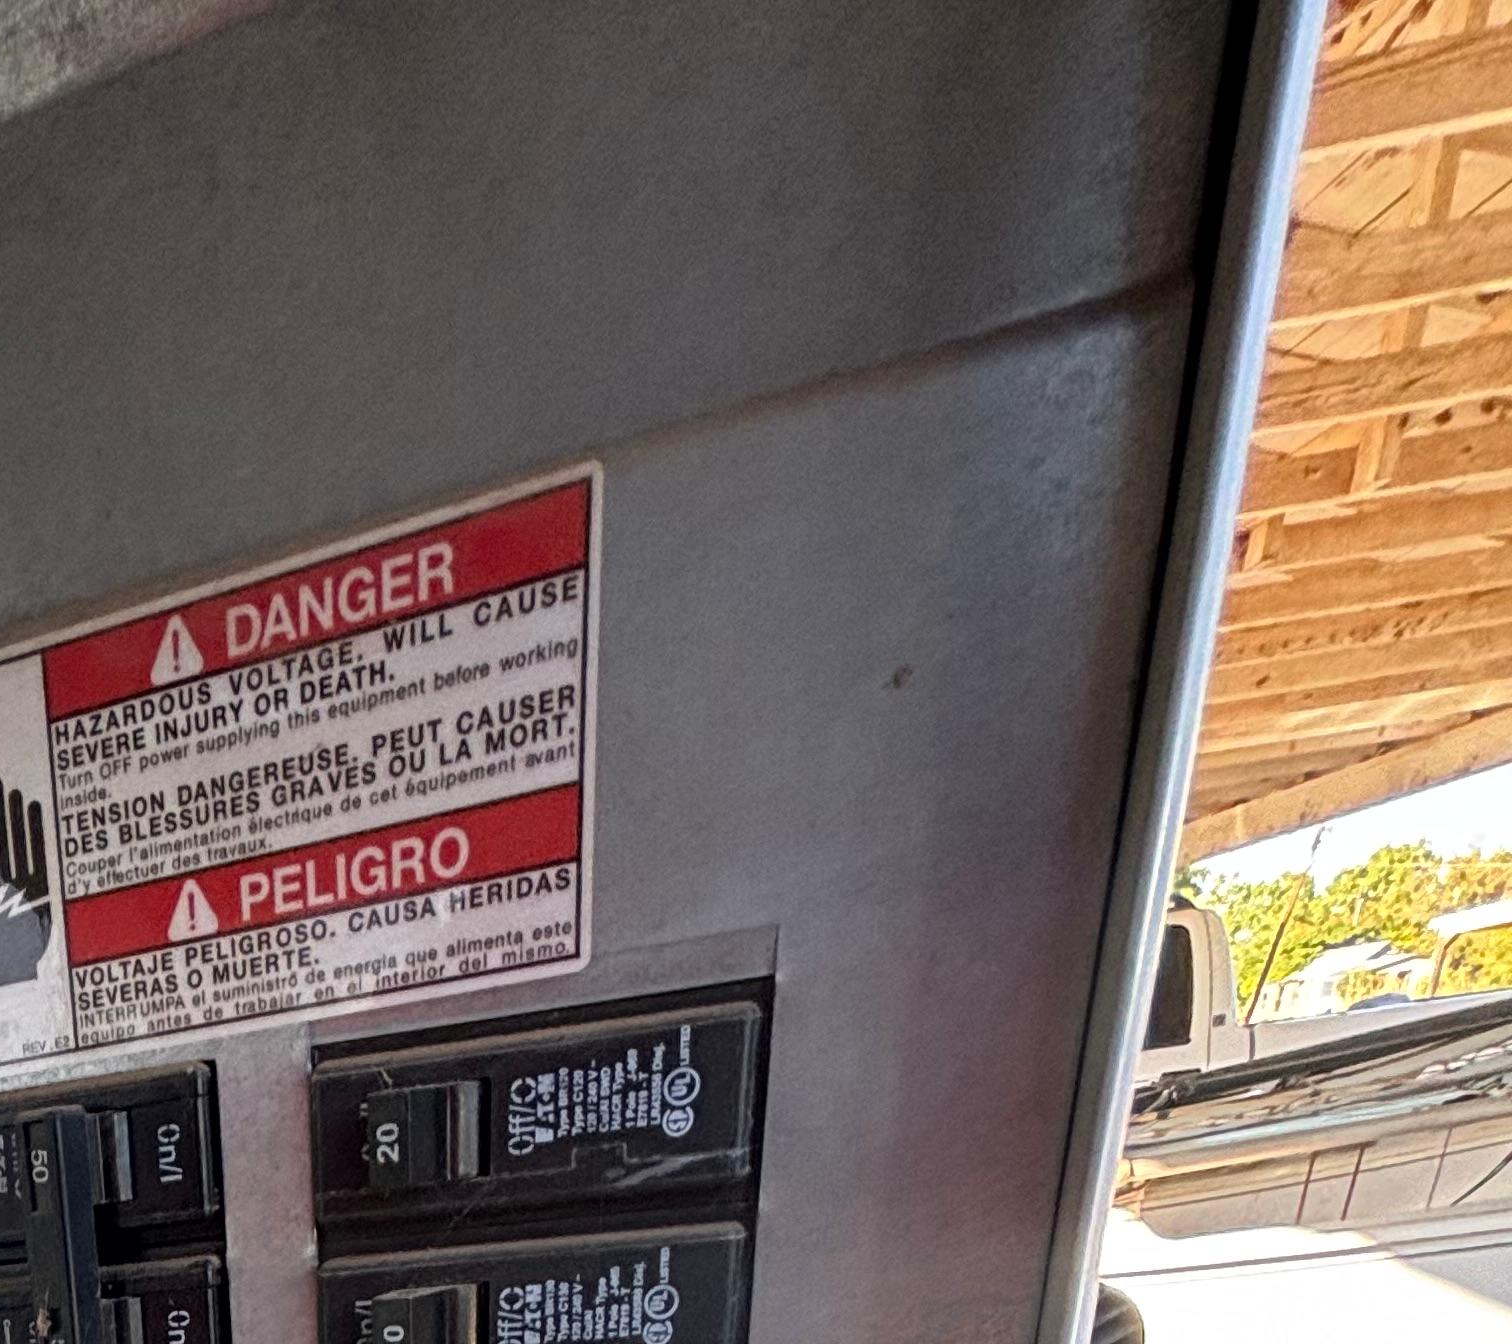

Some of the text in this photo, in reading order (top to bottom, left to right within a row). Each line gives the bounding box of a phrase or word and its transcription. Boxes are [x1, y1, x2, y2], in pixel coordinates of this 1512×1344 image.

[225, 538, 452, 660] DANGER
[54, 680, 211, 746] HAZARDOUS
[383, 609, 452, 654] WILL
[473, 572, 578, 629] CAUSE
[58, 633, 578, 791] Turn OFF power supplying this equipment before working
[56, 656, 394, 772] SEVERE INJURY OR DEATH.
[61, 683, 574, 836] TENSION DANGEREUSE. PEUT CAUSER
[64, 709, 574, 859] DES BLESSURES GRAVES OU LA MORT.
[65, 849, 122, 881] Couper
[339, 791, 361, 813] de
[369, 783, 396, 806] cet
[524, 739, 574, 769] avant
[96, 858, 165, 889] effectuer
[171, 850, 200, 871] des
[240, 823, 468, 921] PELIGRO
[75, 866, 570, 990] VOLTAJE PELIGROSO. CAUSA HERIDAS
[191, 989, 205, 1007] el
[304, 966, 324, 984] de
[405, 947, 437, 968] que
[446, 927, 523, 960] alimenta
[531, 918, 572, 942] este
[77, 972, 178, 1011] SEVERAS
[186, 967, 202, 990] O
[80, 1022, 135, 1046] equipo
[146, 1010, 191, 1032] antes
[202, 1003, 223, 1021] de
[235, 989, 301, 1016] trabajar
[314, 985, 334, 1000] en
[346, 975, 361, 993] el
[376, 961, 445, 990] interior
[459, 953, 487, 973] del
[30, 1149, 49, 1183] 50
[157, 1123, 184, 1183] On/I
[376, 1122, 400, 1164] 20
